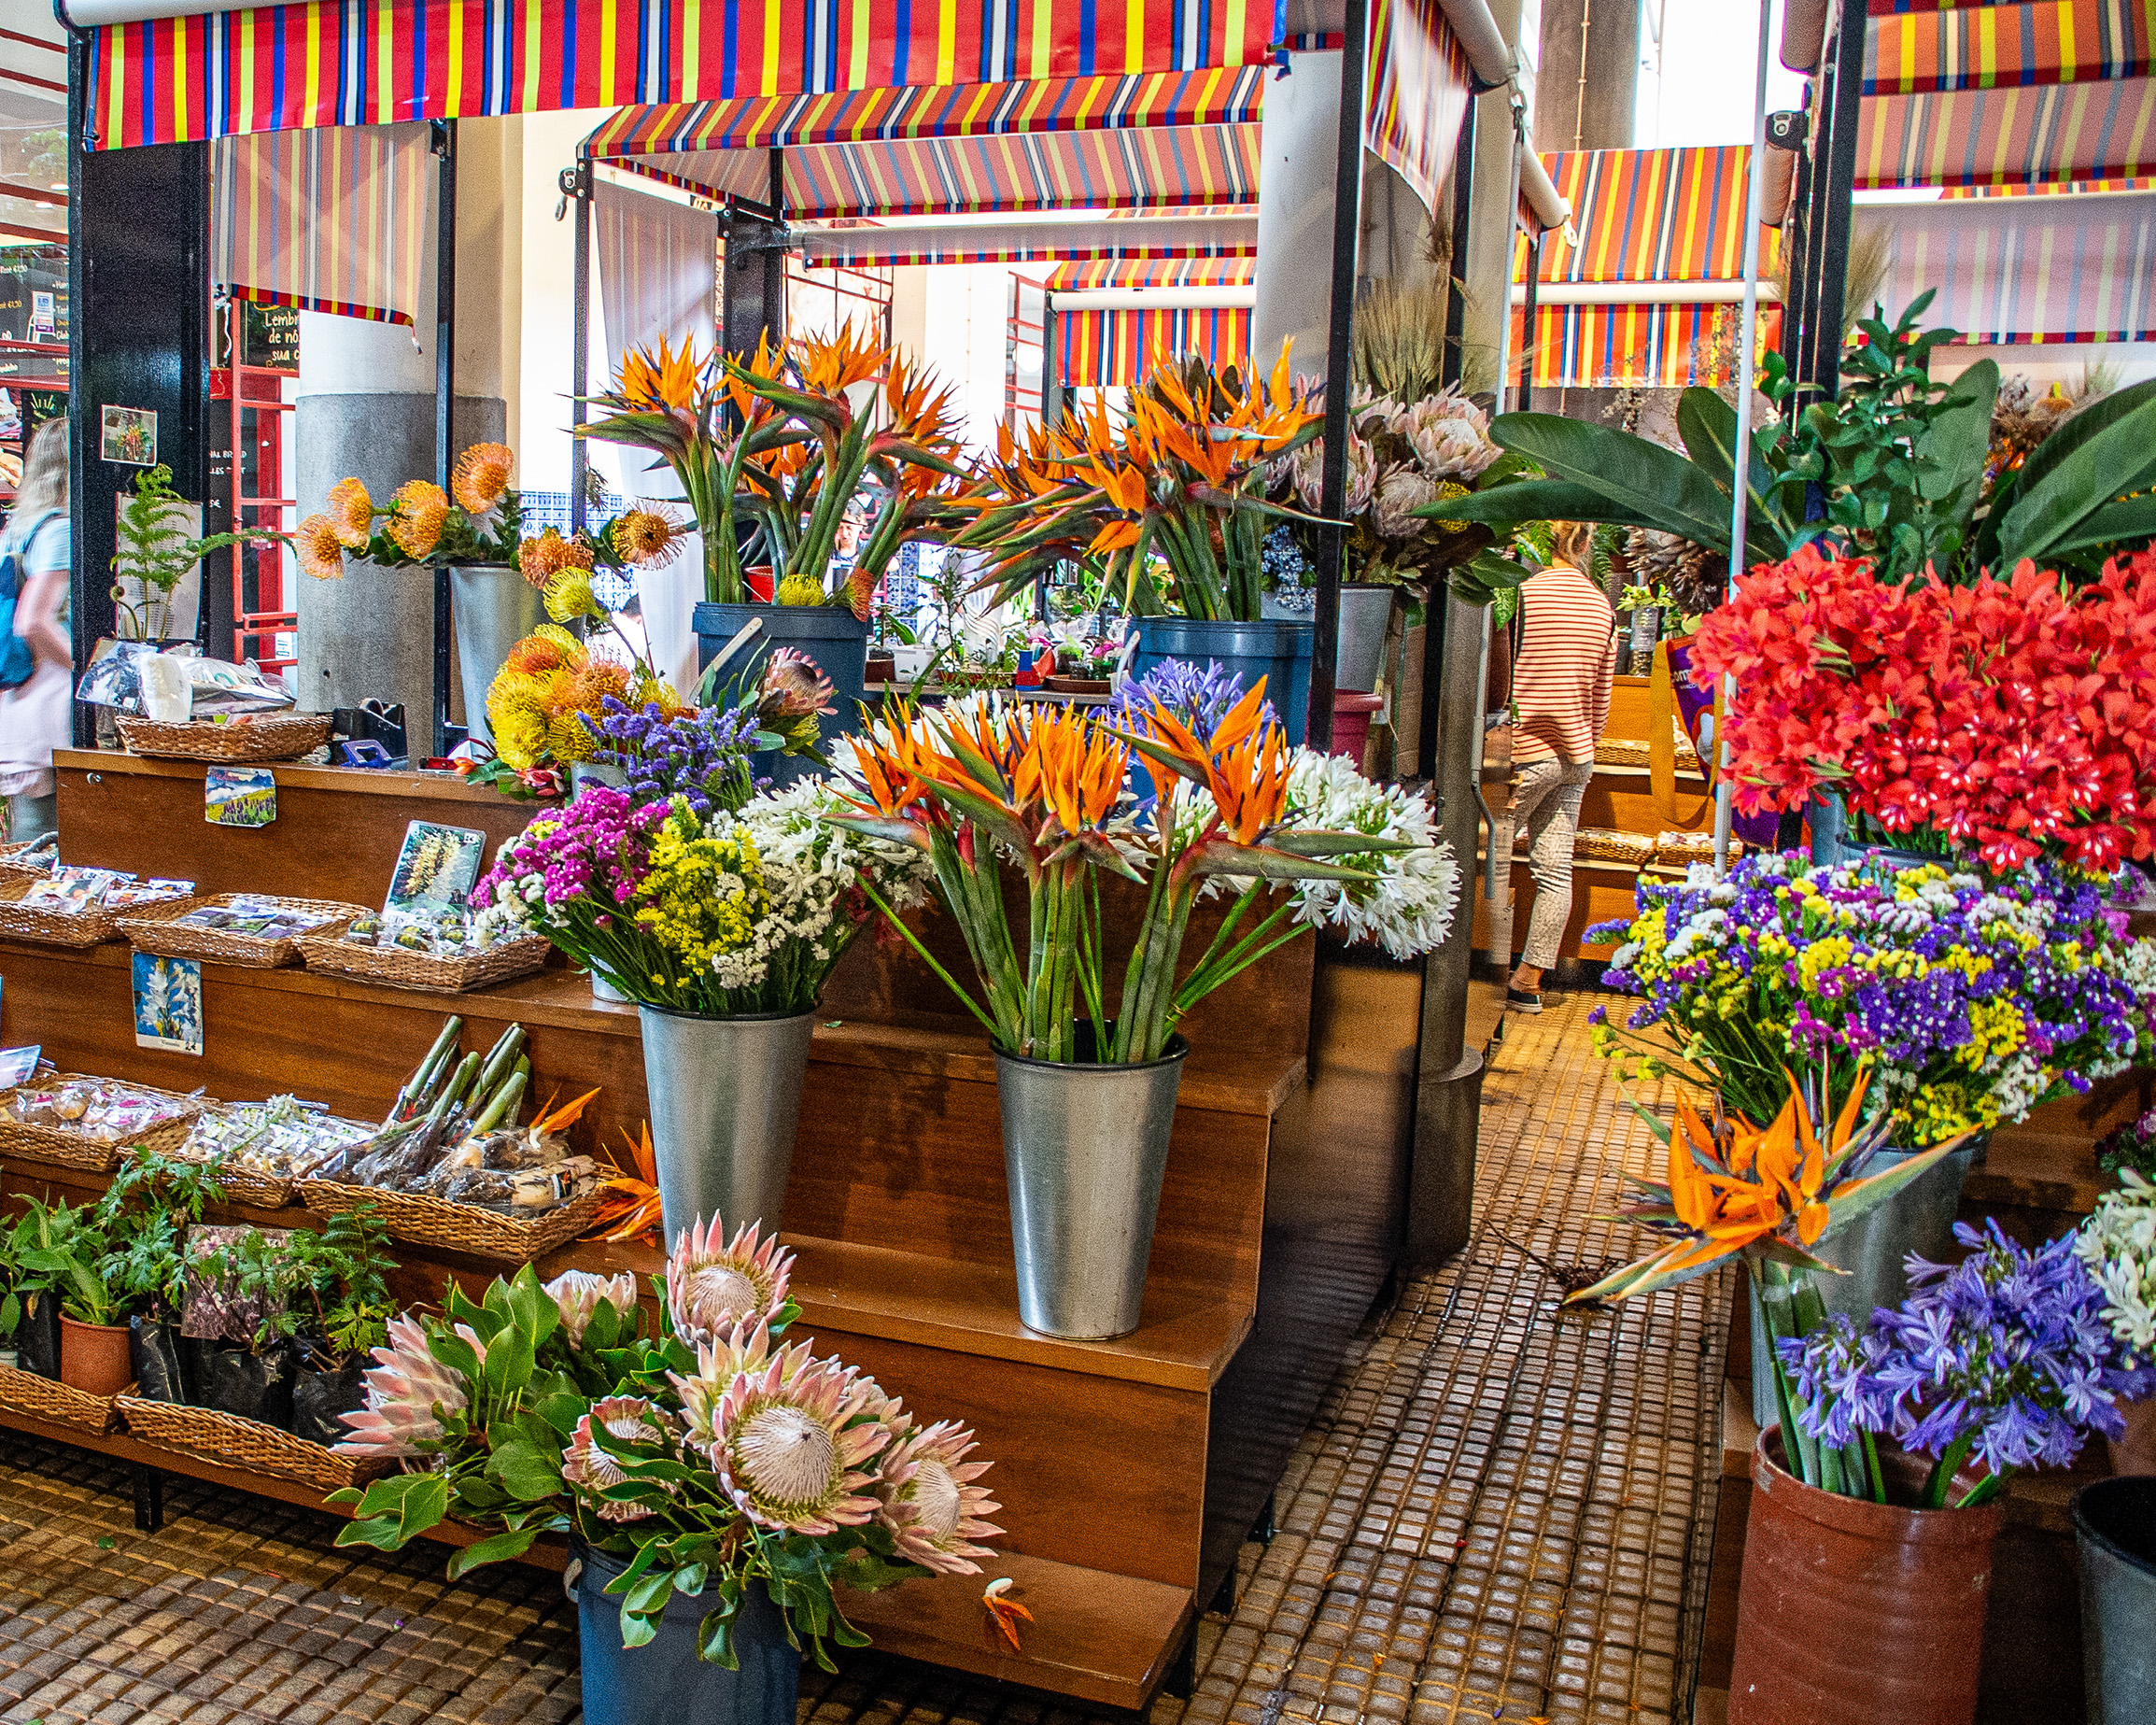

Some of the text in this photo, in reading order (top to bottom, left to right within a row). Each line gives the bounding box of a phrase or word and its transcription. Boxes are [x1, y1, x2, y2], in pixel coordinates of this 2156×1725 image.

[265, 310, 299, 327] Lembr
[268, 327, 281, 344] de
[272, 349, 290, 361] sua
